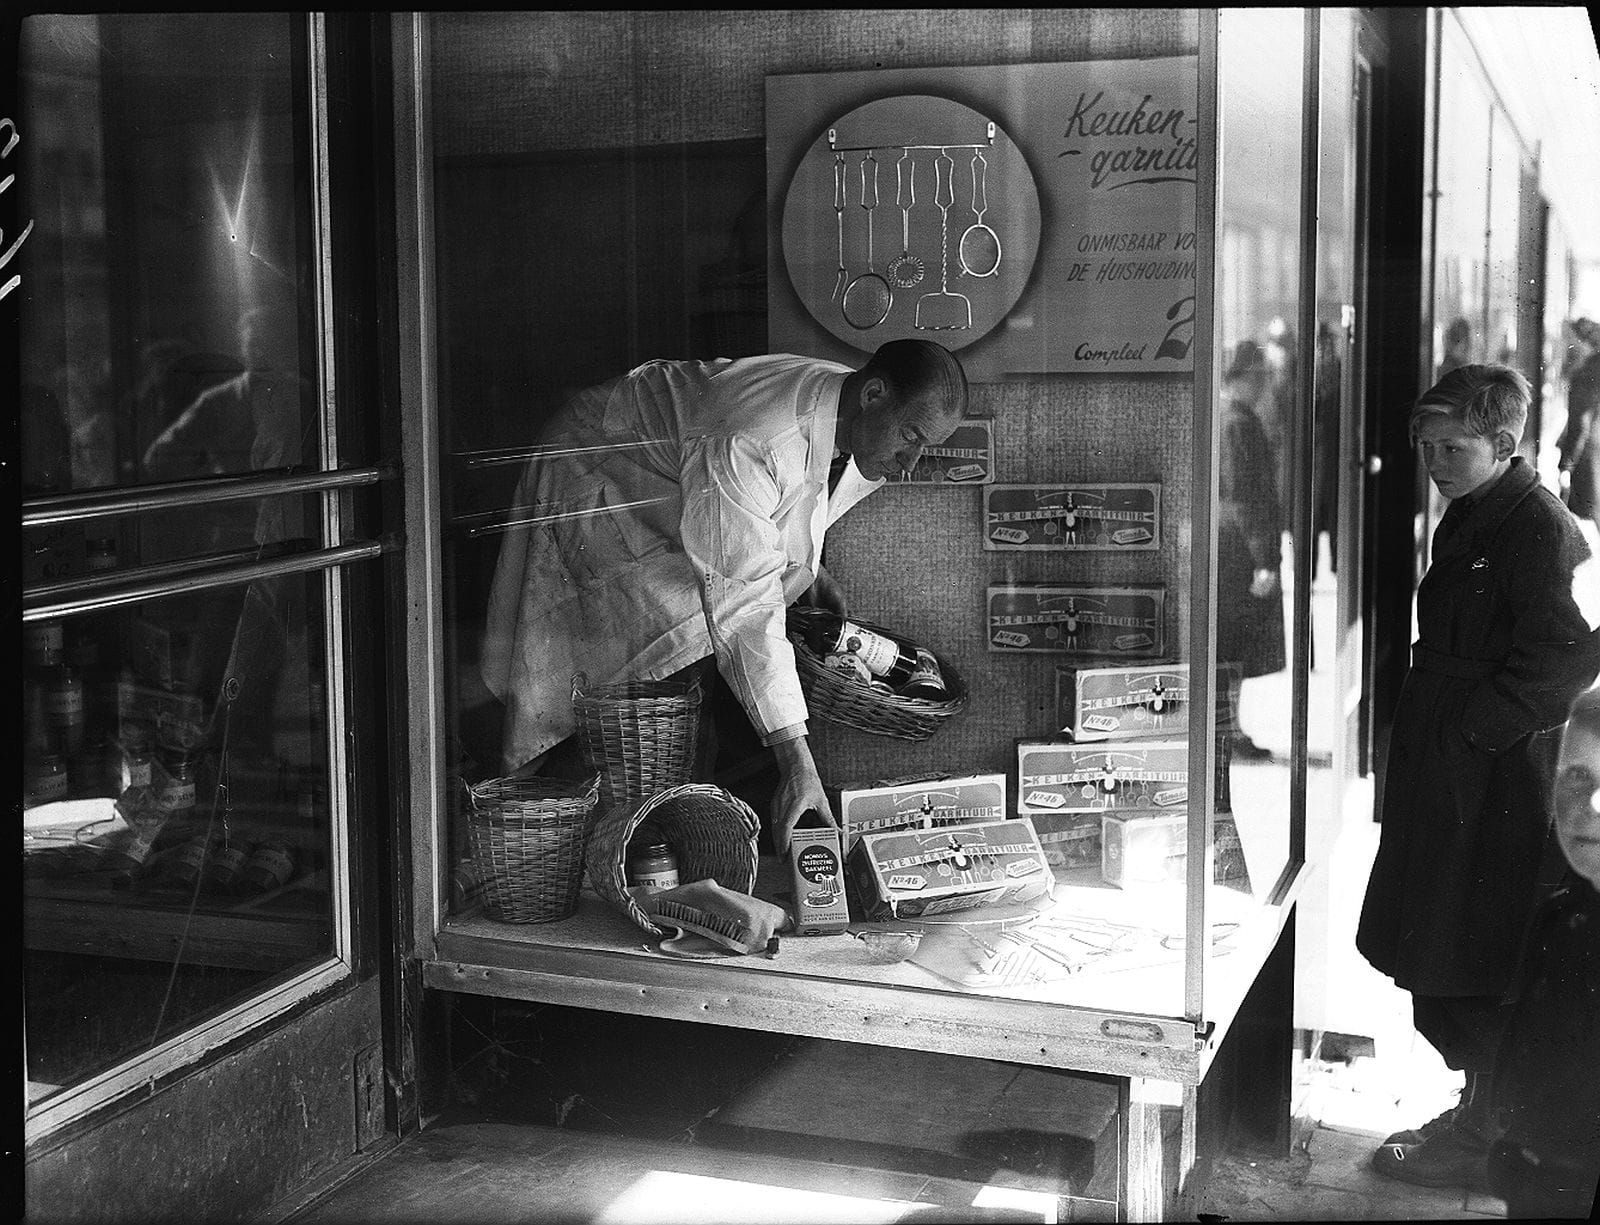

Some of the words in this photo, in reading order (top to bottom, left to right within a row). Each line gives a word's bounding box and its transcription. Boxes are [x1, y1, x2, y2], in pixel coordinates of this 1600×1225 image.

[1064, 91, 1197, 138] Keuken-
[1077, 231, 1167, 252] ONMISBAAR
[1174, 232, 1196, 250] VO
[1067, 262, 1091, 282] DE
[1074, 342, 1147, 366] Compleet
